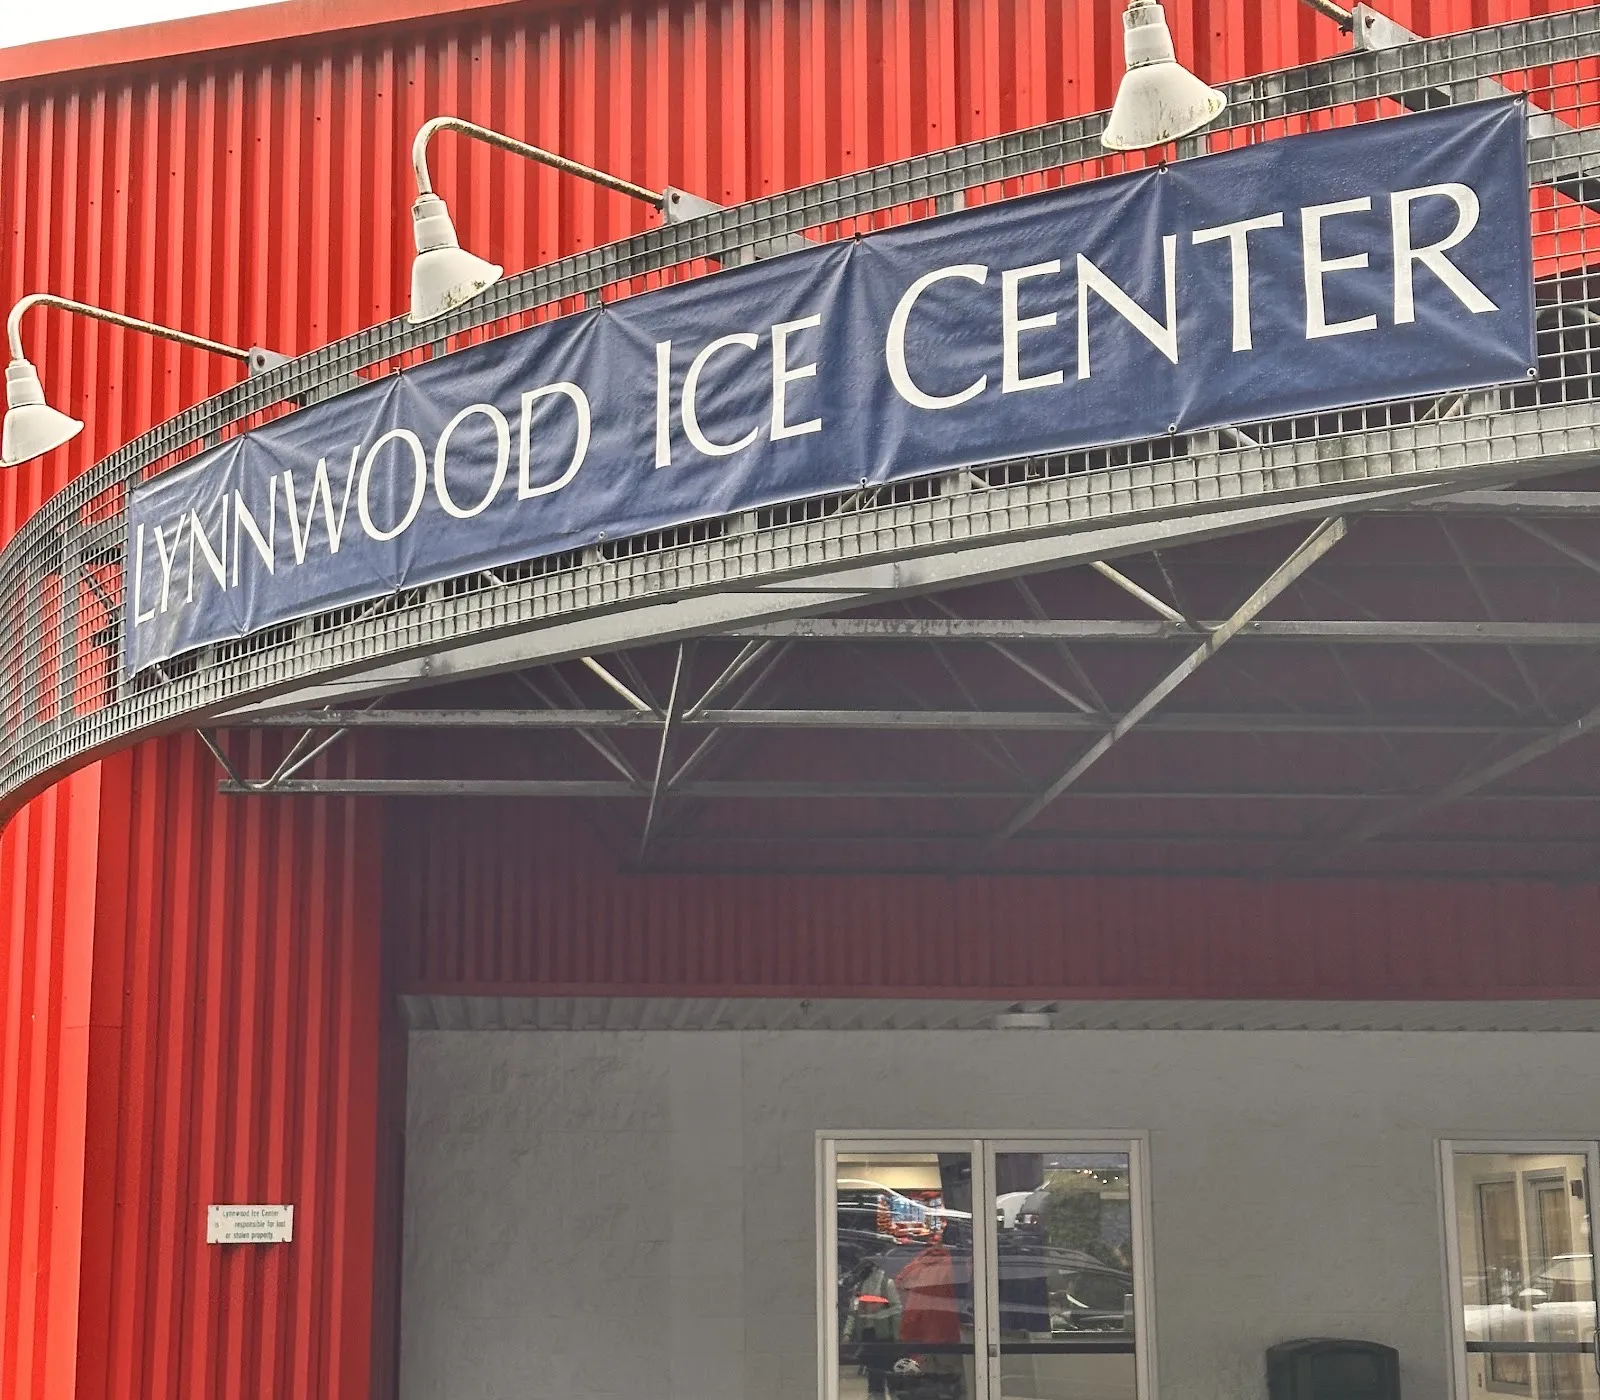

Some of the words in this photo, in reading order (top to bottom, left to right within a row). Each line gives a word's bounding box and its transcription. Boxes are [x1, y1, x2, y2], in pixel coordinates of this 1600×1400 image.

[134, 382, 590, 628] LYNNWOOD
[655, 313, 823, 469] ICE
[886, 182, 1498, 411] CENTER
[251, 1209, 260, 1217] Ice
[261, 1209, 279, 1217] Center
[234, 1220, 265, 1229] responsible
[251, 1232, 273, 1240] property
